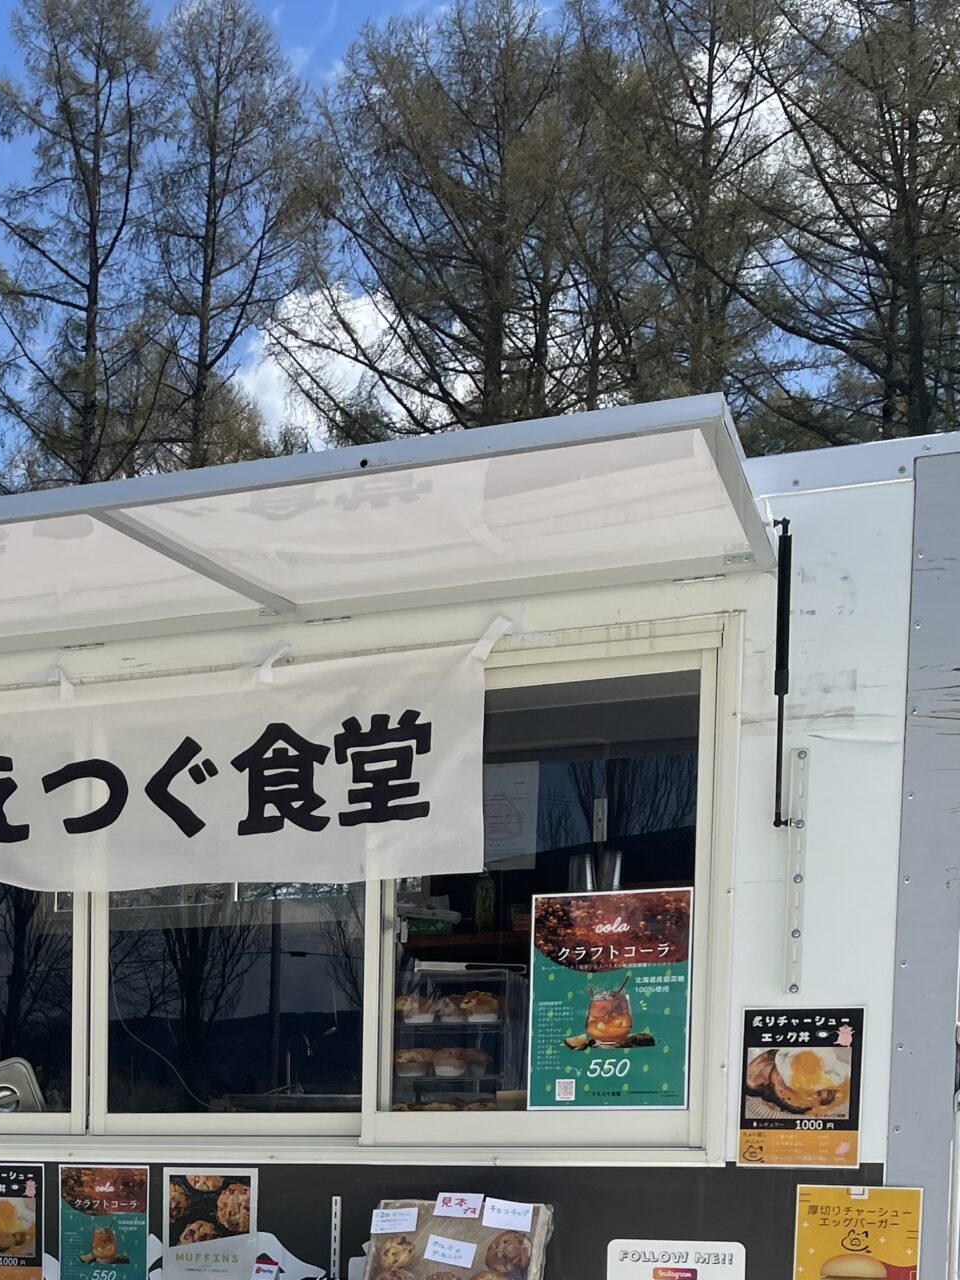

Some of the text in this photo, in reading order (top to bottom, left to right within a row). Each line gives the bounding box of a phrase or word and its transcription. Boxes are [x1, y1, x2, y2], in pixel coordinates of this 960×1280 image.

[595, 916, 630, 934] cola
[557, 943, 670, 961] クラフトコーラ
[752, 1015, 850, 1027] 炙りチャーシュー
[761, 1031, 810, 1042] エッグ丼
[795, 1120, 823, 1130] 1000
[74, 1199, 137, 1209] クラフトコーラ
[442, 1196, 467, 1207] 見本
[807, 1204, 912, 1218] 厚切りチャーシュー
[819, 1217, 900, 1230] エッグバーガー
[175, 1252, 240, 1263] MUFFINS
[619, 1250, 734, 1265] FOLLOW ME!!
[658, 1270, 692, 1279] Instagram
